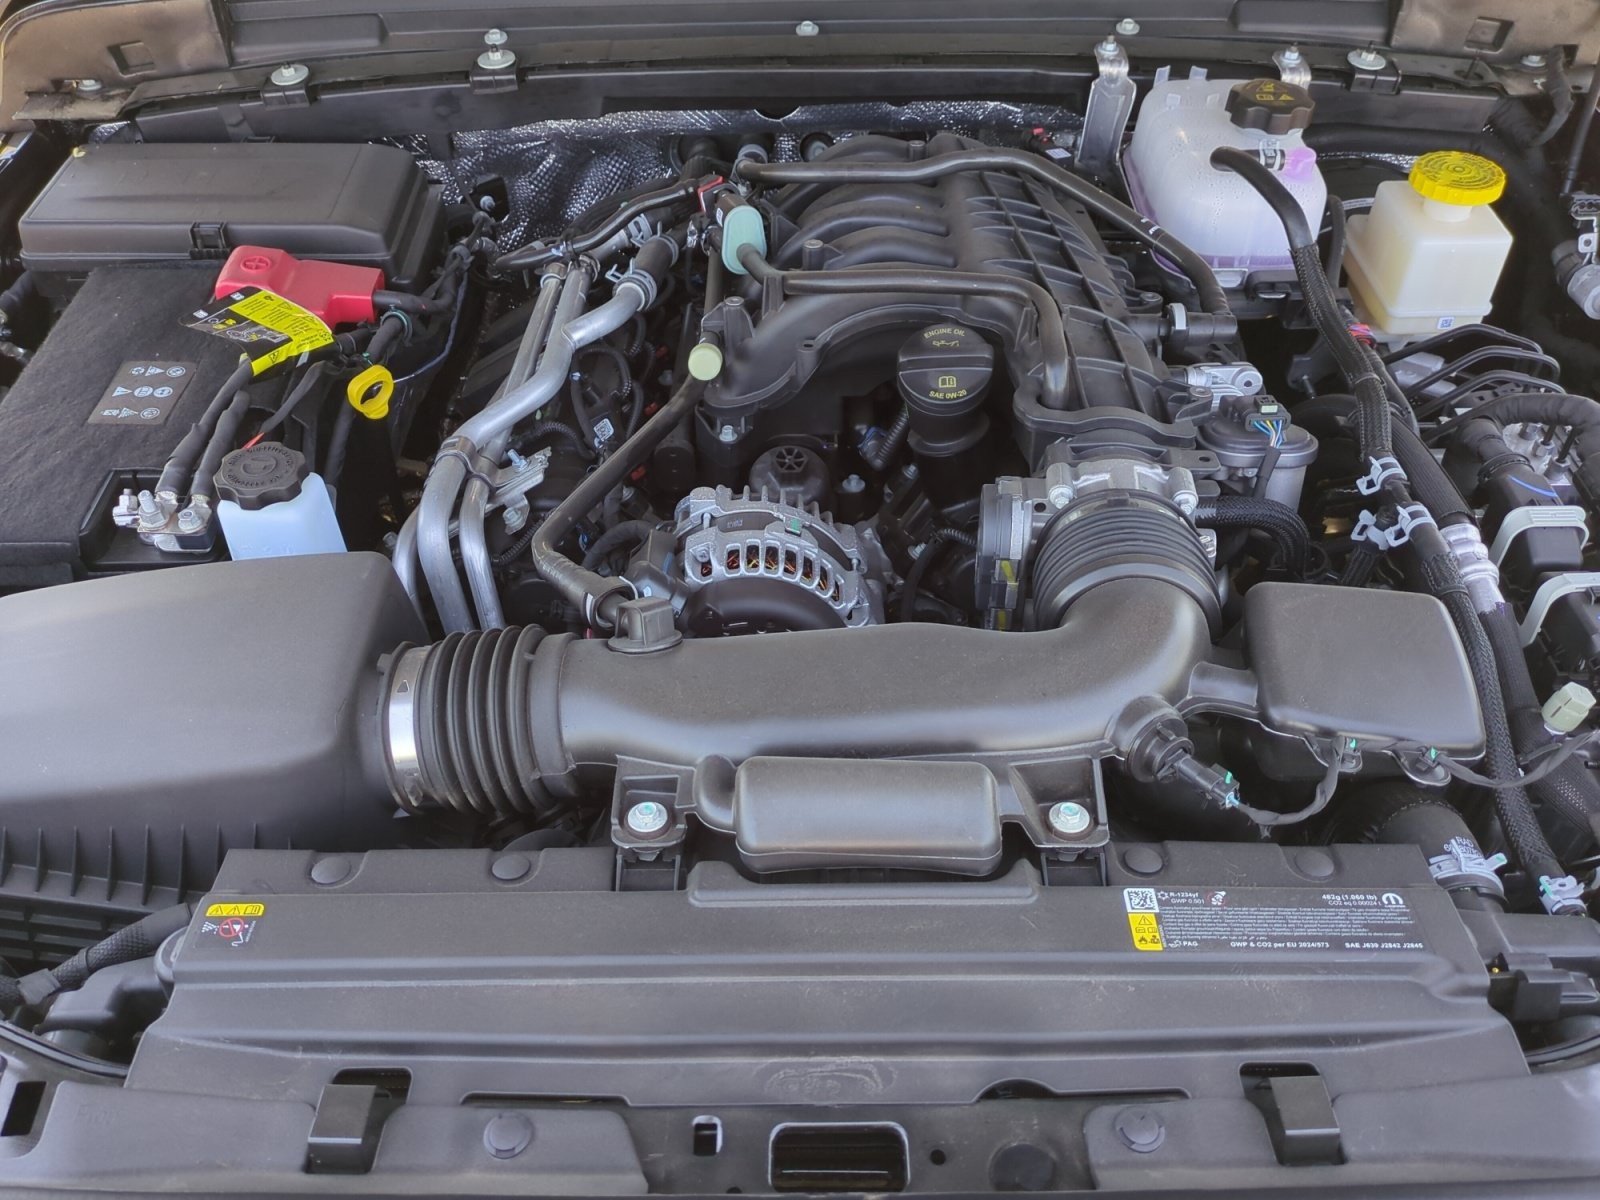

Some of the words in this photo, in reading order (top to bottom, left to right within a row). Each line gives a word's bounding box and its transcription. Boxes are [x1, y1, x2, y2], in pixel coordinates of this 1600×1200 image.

[924, 328, 952, 339] ENGINE
[929, 390, 944, 399] SAE
[945, 389, 967, 399] 0W-20
